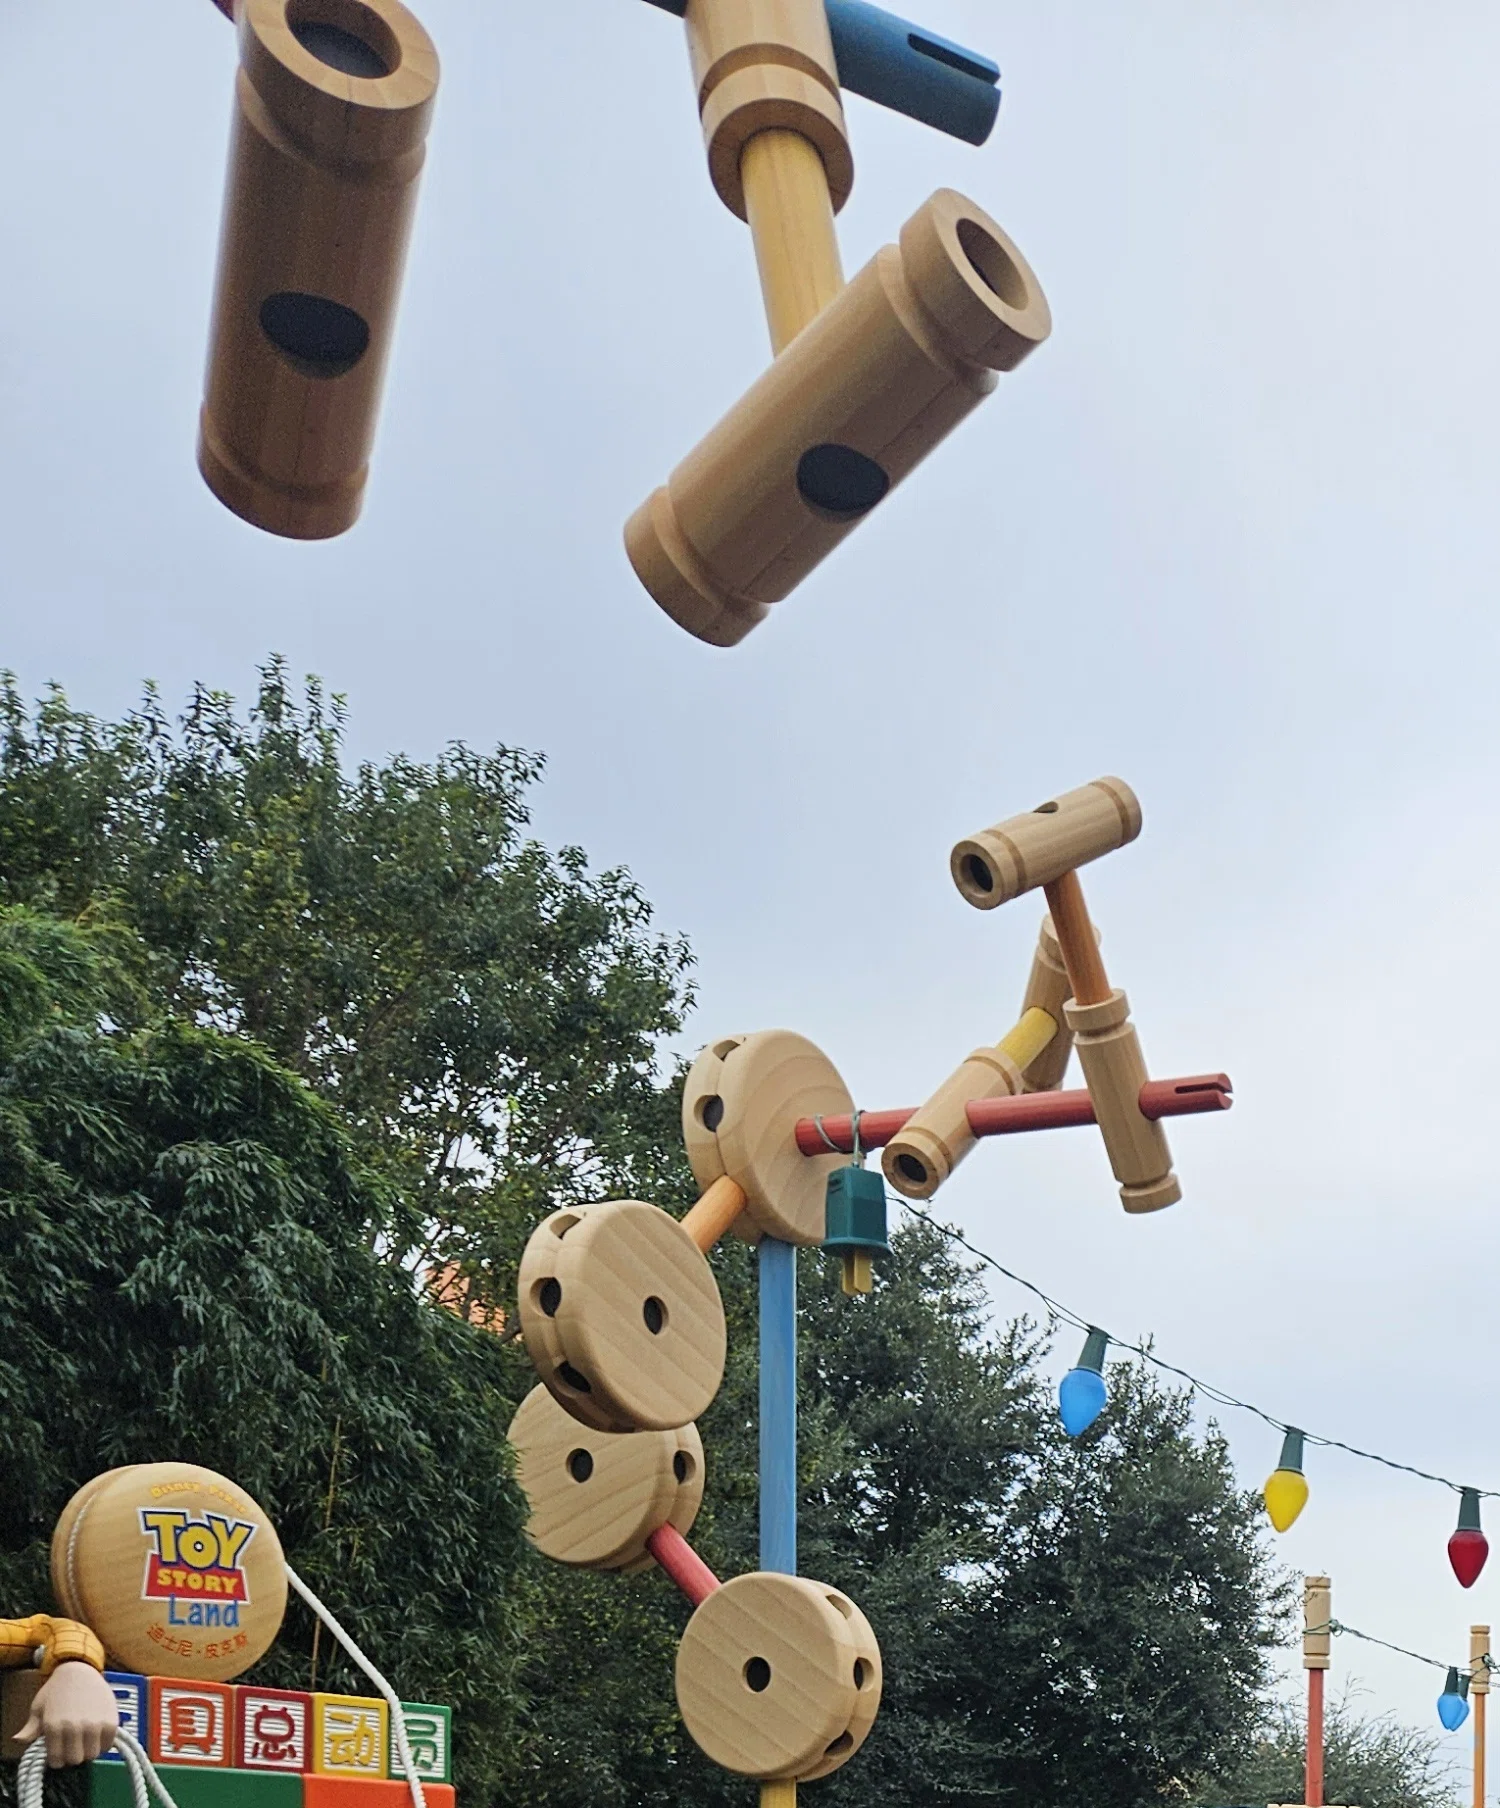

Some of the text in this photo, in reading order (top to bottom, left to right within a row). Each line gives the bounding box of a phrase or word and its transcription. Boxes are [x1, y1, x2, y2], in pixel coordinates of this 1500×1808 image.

[141, 1510, 255, 1571] TOY
[156, 1567, 239, 1595] STORY
[168, 1593, 240, 1627] Land
[112, 1689, 439, 1771] 具总动员
